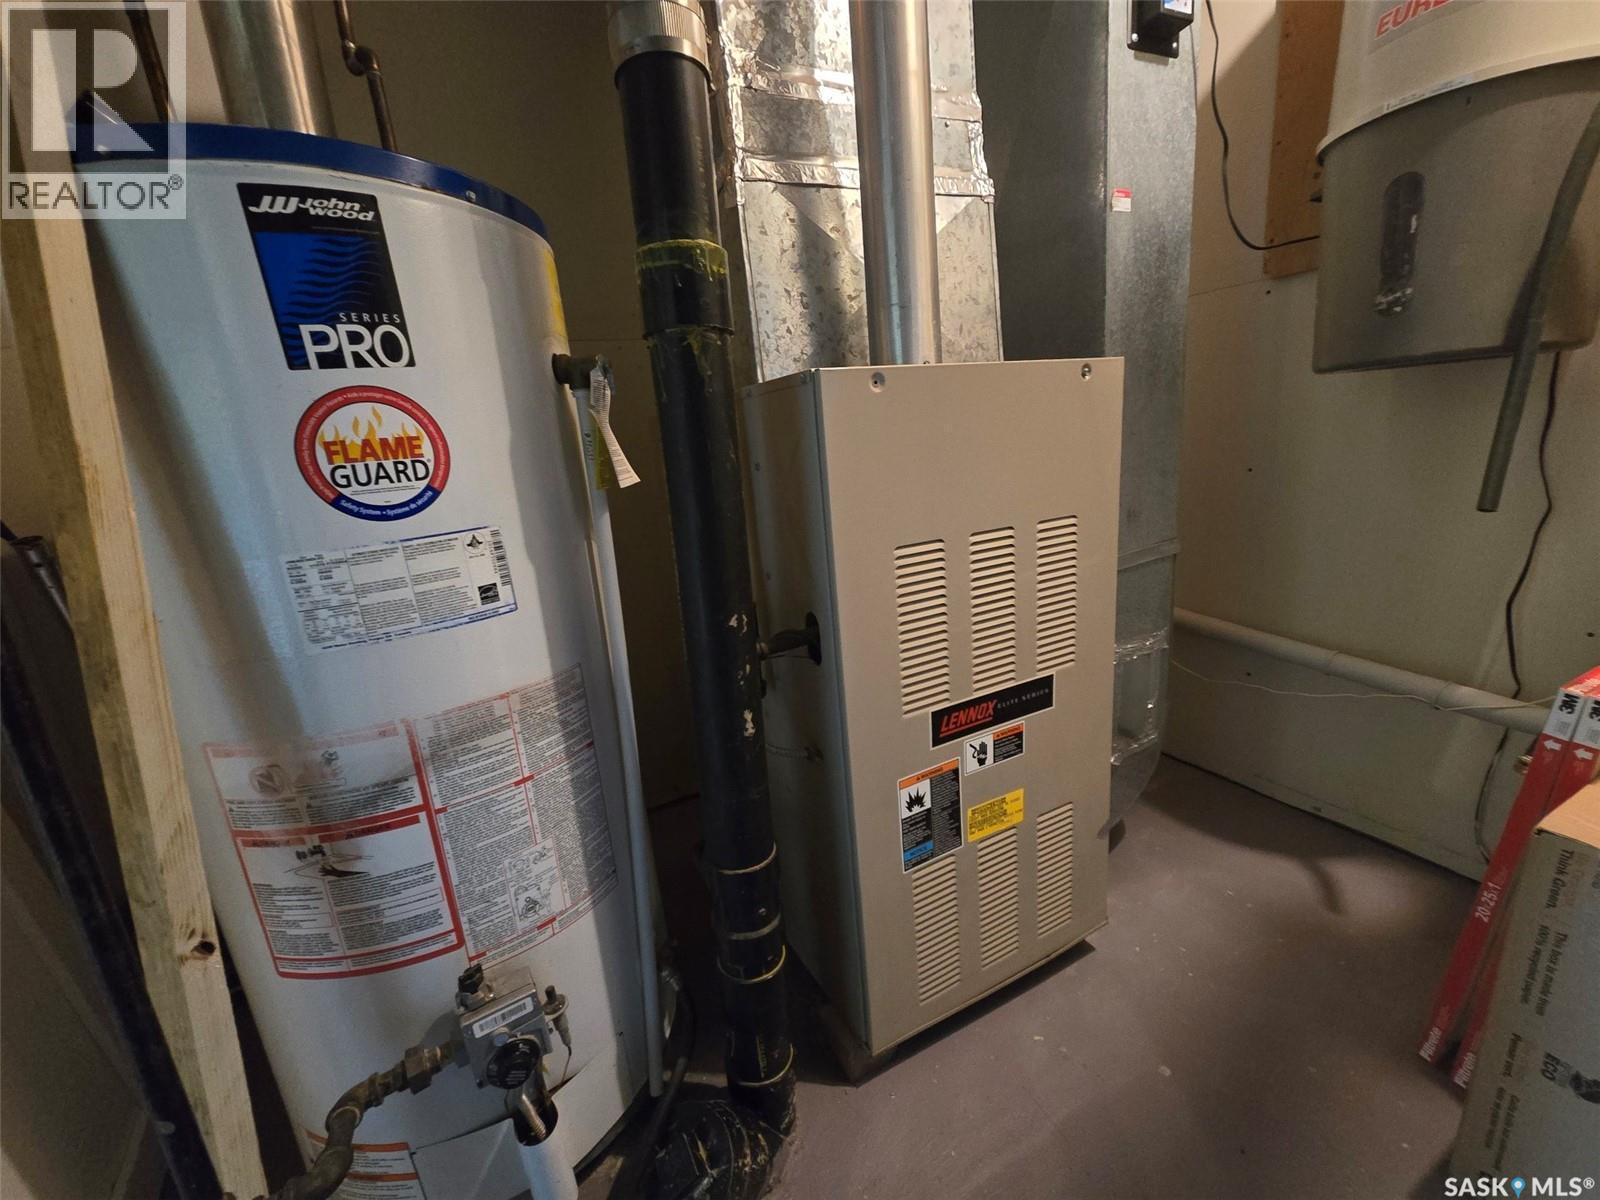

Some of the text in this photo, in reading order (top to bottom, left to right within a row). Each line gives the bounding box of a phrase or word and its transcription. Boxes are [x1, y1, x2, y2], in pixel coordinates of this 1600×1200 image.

[308, 207, 375, 222] wood
[339, 312, 401, 324] SERIES
[299, 324, 410, 370] PRO
[323, 435, 425, 465] FLAME
[940, 699, 998, 732] LENNOX
[1021, 688, 1049, 701] SERIES
[1559, 693, 1580, 714] 3M
[1555, 849, 1575, 876] Think
[1549, 948, 1562, 966] box
[1540, 973, 1554, 997] made
[1541, 1052, 1560, 1081] ECO
